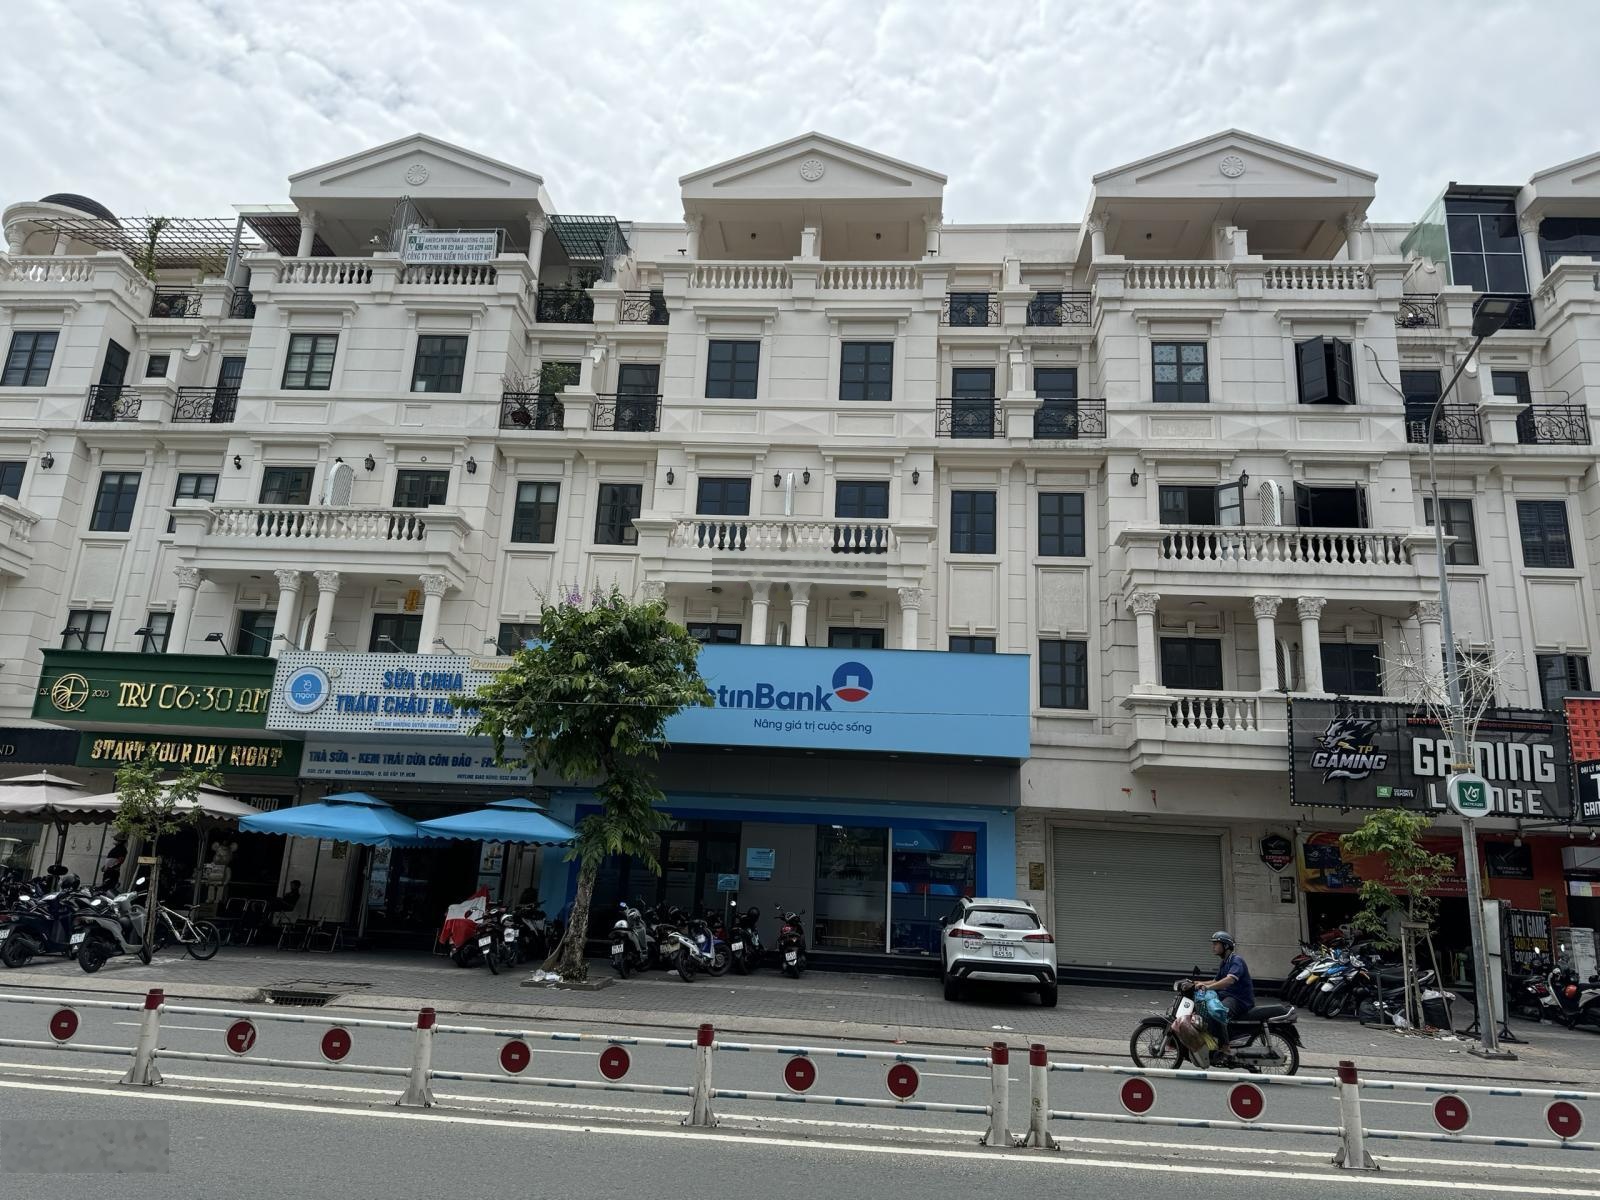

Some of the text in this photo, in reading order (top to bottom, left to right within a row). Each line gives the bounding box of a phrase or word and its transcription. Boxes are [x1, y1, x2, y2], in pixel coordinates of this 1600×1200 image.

[382, 667, 464, 692] SỮA CHUA
[117, 682, 272, 714] TRY 06:30 AM
[382, 692, 430, 715] CHÂU
[753, 718, 872, 734] Nâng giá trị cuộc sống
[91, 738, 284, 768] START YOUR DAY RIGHT
[309, 748, 326, 763] TRÀ
[329, 749, 349, 763] SỮA
[358, 753, 380, 764] KEM
[1311, 752, 1388, 770] GAMING
[1358, 745, 1373, 754] TP
[1412, 737, 1556, 783] GAMING
[1526, 915, 1548, 938] GAME
